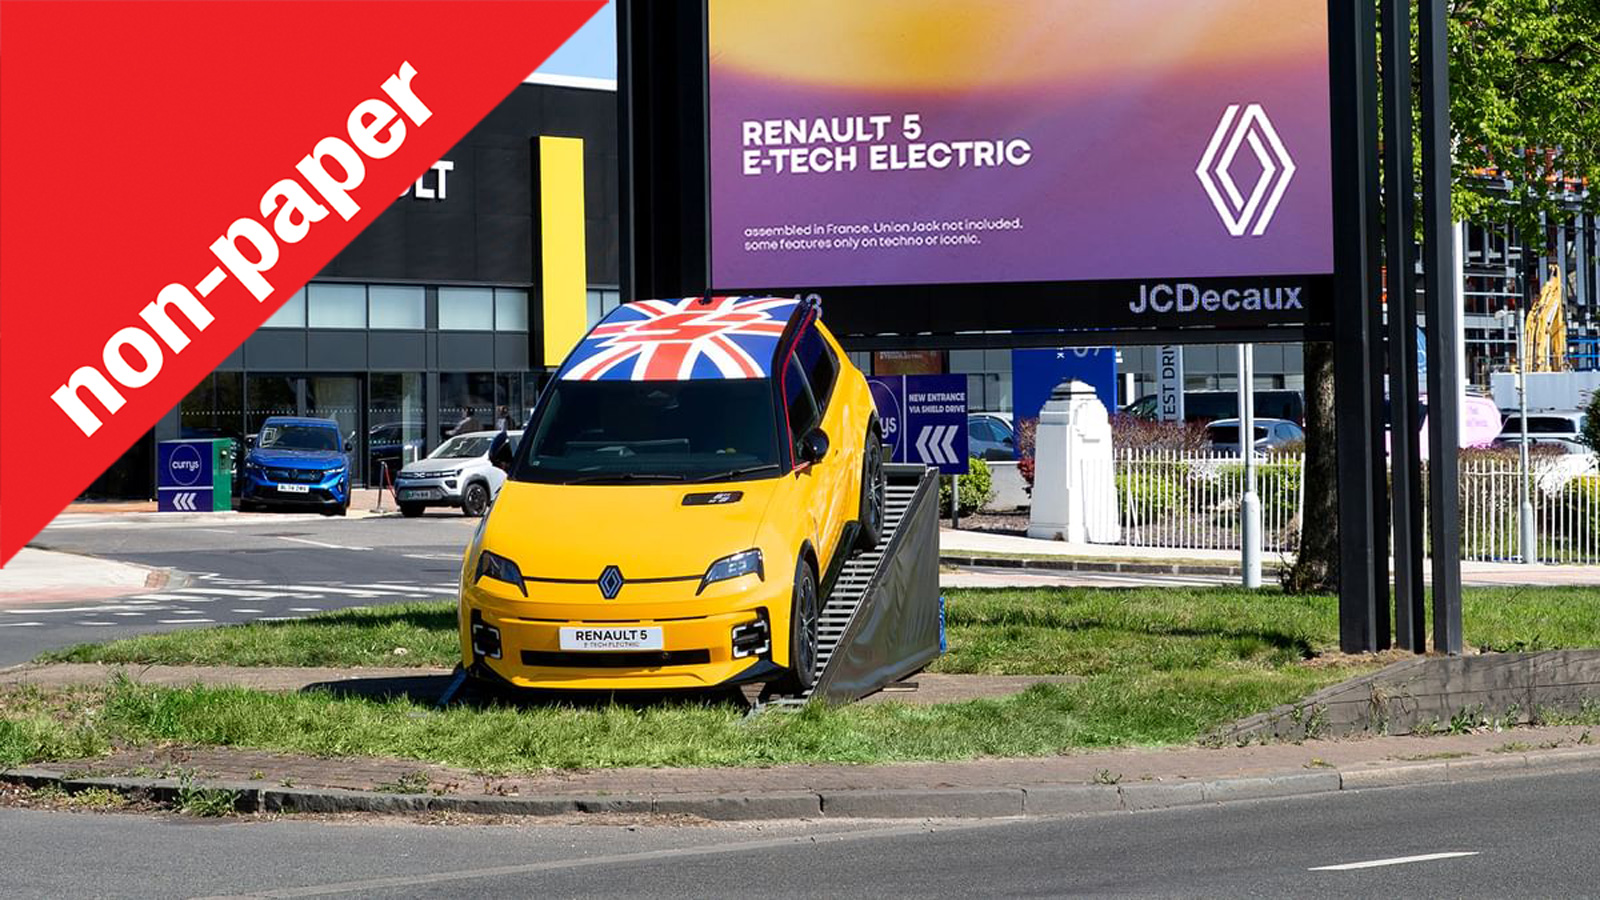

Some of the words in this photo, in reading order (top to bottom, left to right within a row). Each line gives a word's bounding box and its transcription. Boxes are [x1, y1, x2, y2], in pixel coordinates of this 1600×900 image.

[742, 115, 892, 146] RENAULT
[903, 114, 922, 140] 5
[742, 146, 857, 175] E-TECH
[870, 139, 1032, 171] ELECTRIC
[398, 159, 454, 199] LT
[743, 225, 812, 237] assembled
[813, 223, 826, 235] in
[826, 222, 874, 235] France.
[873, 221, 911, 234] Union
[911, 220, 941, 233] Jack
[941, 221, 964, 232] not
[964, 217, 1024, 231] included.
[743, 240, 779, 252] some
[779, 238, 832, 250] features
[832, 237, 861, 251] only
[861, 238, 878, 248] on
[879, 235, 925, 247] techno
[925, 235, 939, 247] or
[1128, 283, 1304, 314] JCDecaux
[908, 393, 926, 402] NEW
[927, 392, 966, 402] ENTRANCE
[908, 405, 921, 414] VIA
[921, 404, 945, 414] SHIELD
[945, 404, 966, 413] DRIVE
[171, 459, 200, 473] currys
[575, 630, 639, 641] RENAULT
[640, 629, 648, 640] 5
